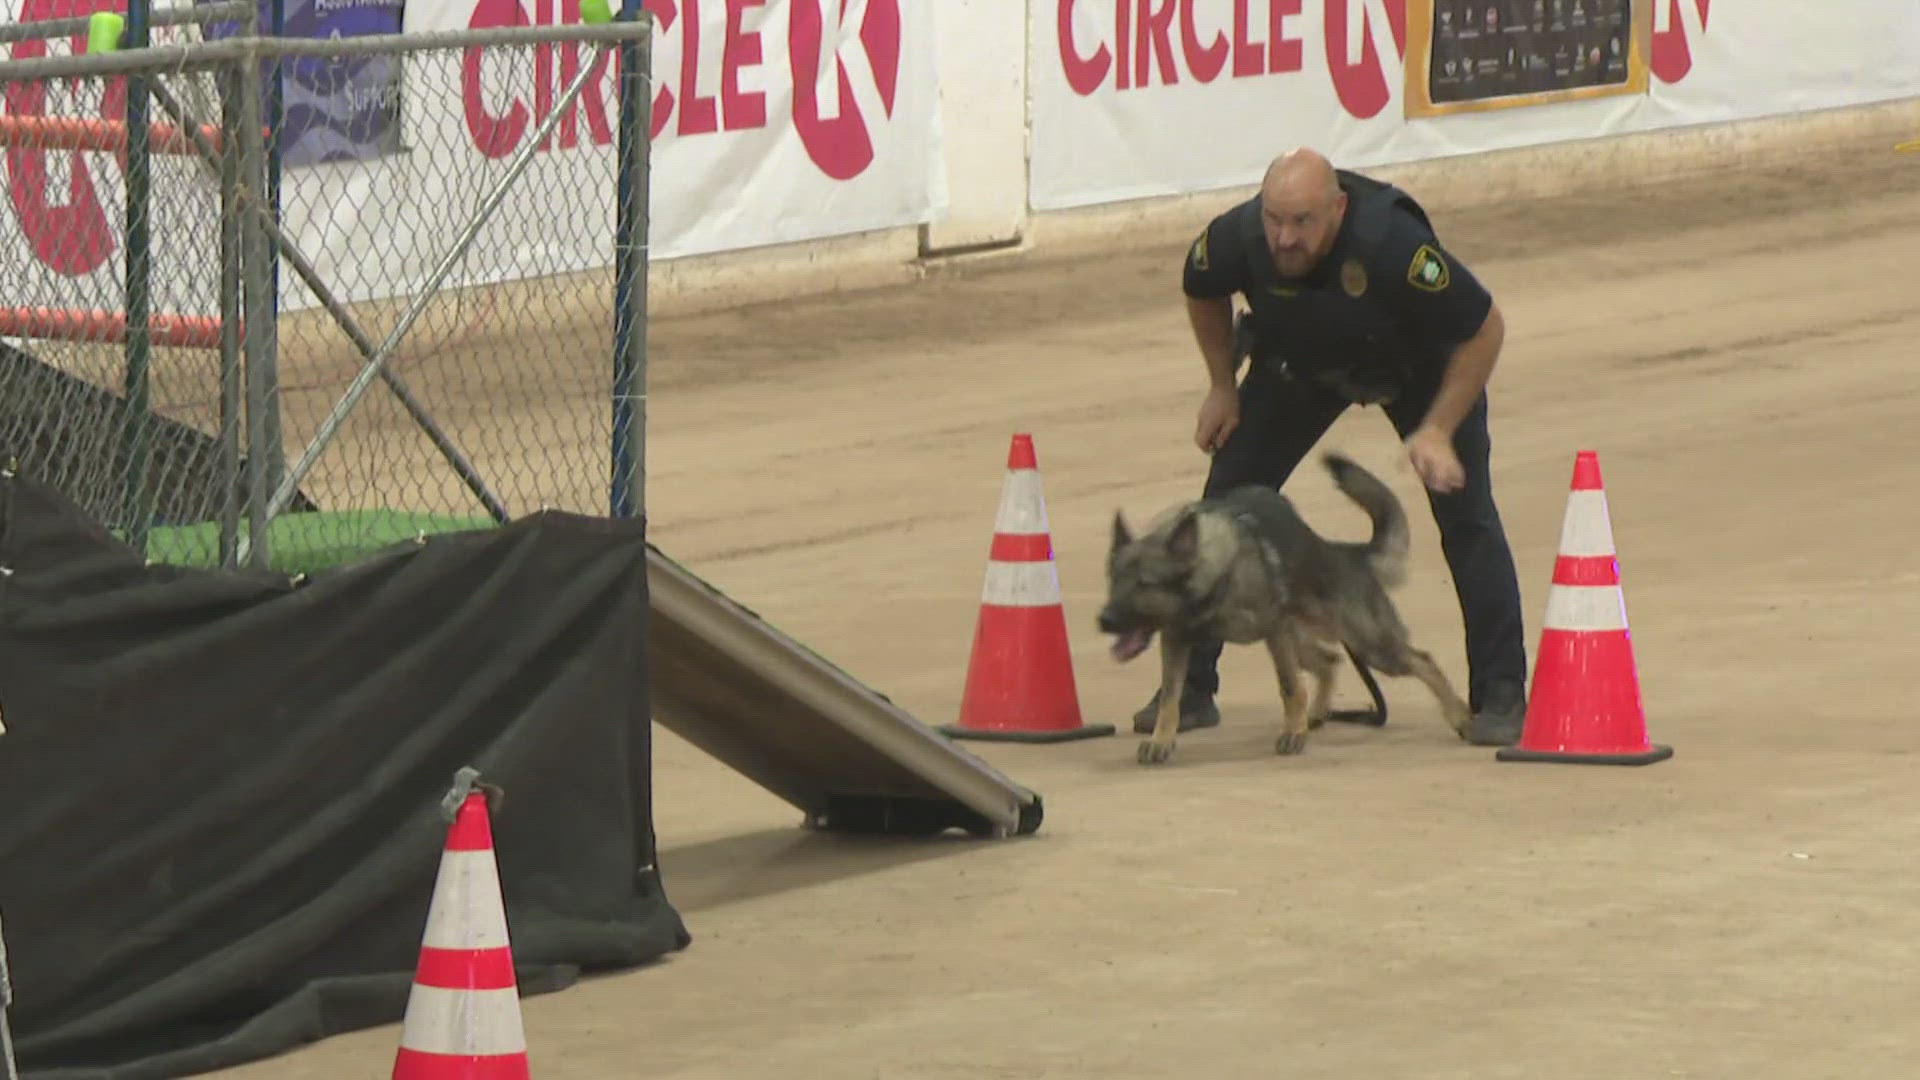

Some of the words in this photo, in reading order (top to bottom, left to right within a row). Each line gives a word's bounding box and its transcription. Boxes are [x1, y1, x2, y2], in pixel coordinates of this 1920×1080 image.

[461, 0, 768, 159] CIRCLE
[790, 0, 900, 180] K
[1057, 0, 1303, 97] CIRCLE
